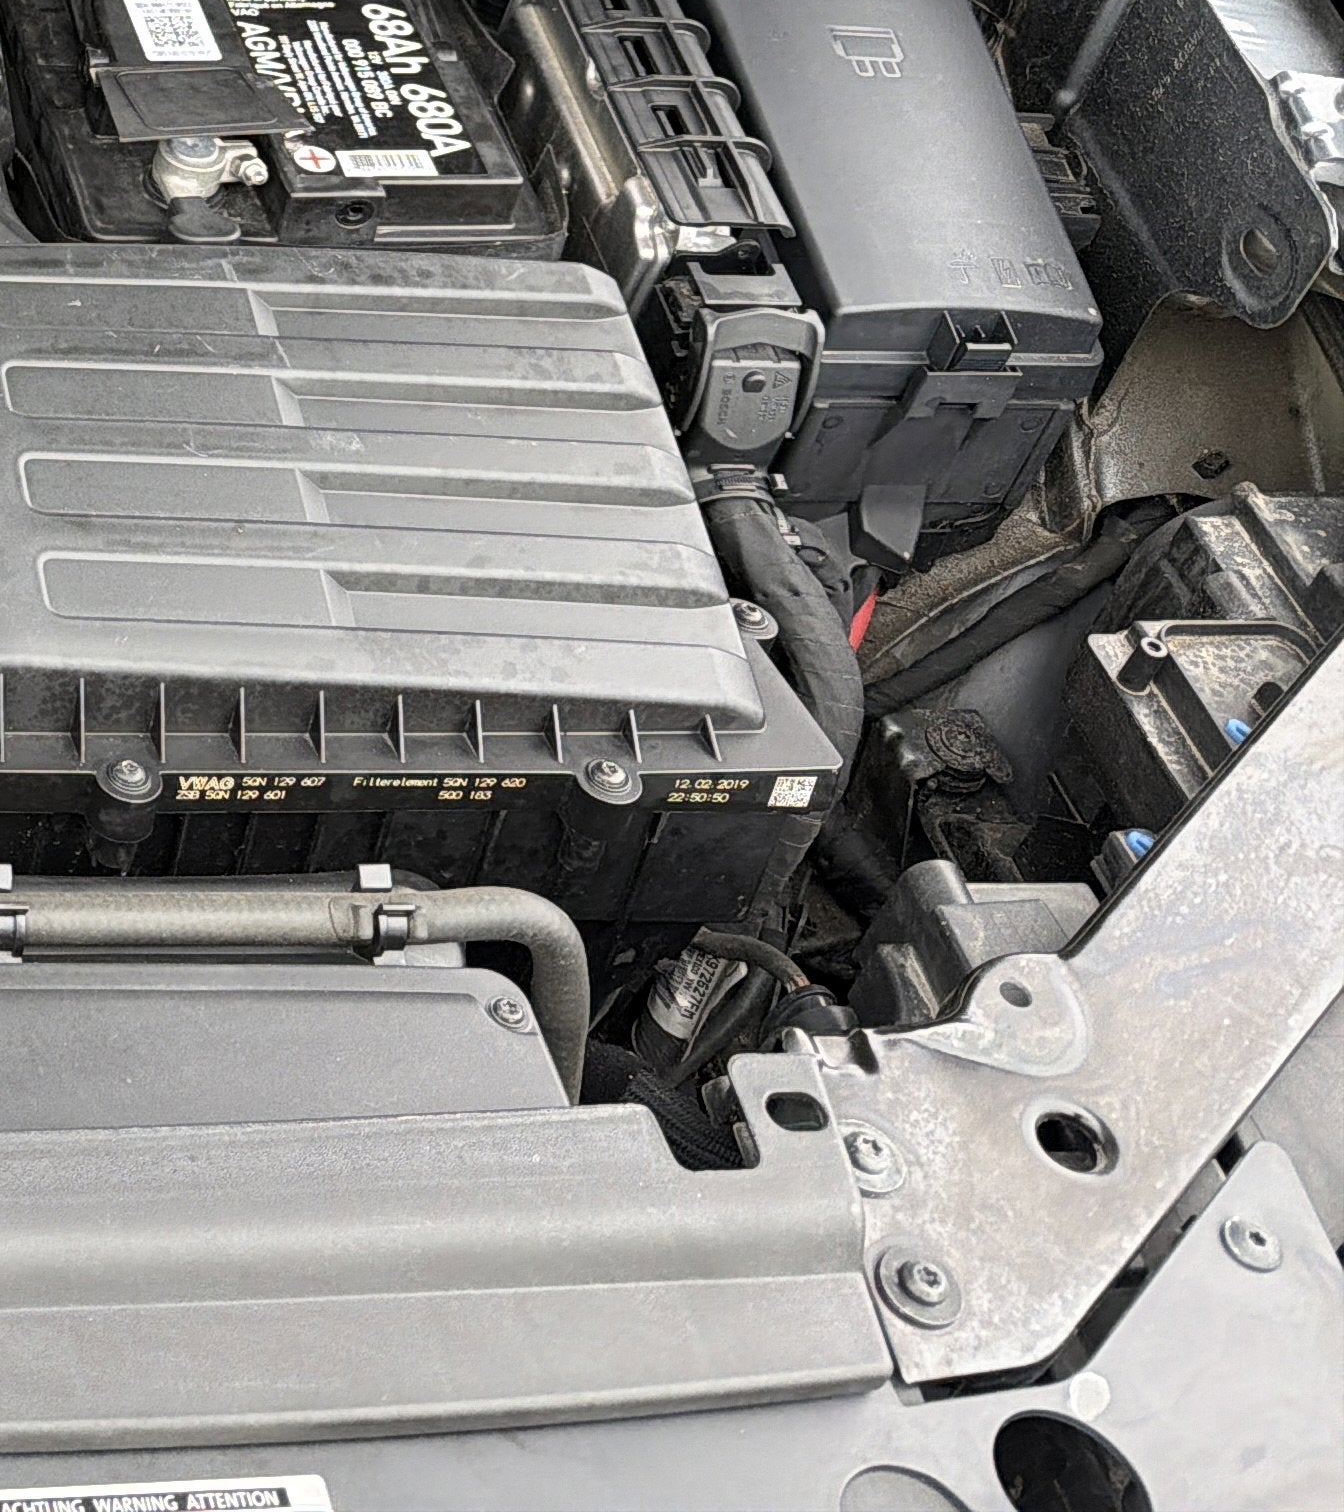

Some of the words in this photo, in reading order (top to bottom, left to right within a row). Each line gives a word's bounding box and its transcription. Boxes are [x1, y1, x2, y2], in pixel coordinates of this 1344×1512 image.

[361, 3, 430, 74] 68Ah
[400, 84, 472, 157] 680A
[717, 388, 732, 426] BOSCH
[179, 776, 234, 790] VWAG
[242, 776, 268, 787] 5QN
[274, 776, 299, 787] 129
[300, 776, 327, 787] 607
[353, 776, 439, 788] Filterelement
[443, 777, 468, 788] 5QN
[475, 777, 497, 788] 129
[501, 777, 526, 788] 620
[674, 778, 751, 791] 12.02.2019
[236, 790, 260, 800] 129
[263, 790, 287, 800] 601
[469, 790, 493, 801] 183
[666, 791, 731, 804] 22:50:50
[92, 1494, 178, 1512] WARNING
[186, 1489, 280, 1509] ATTENTION
